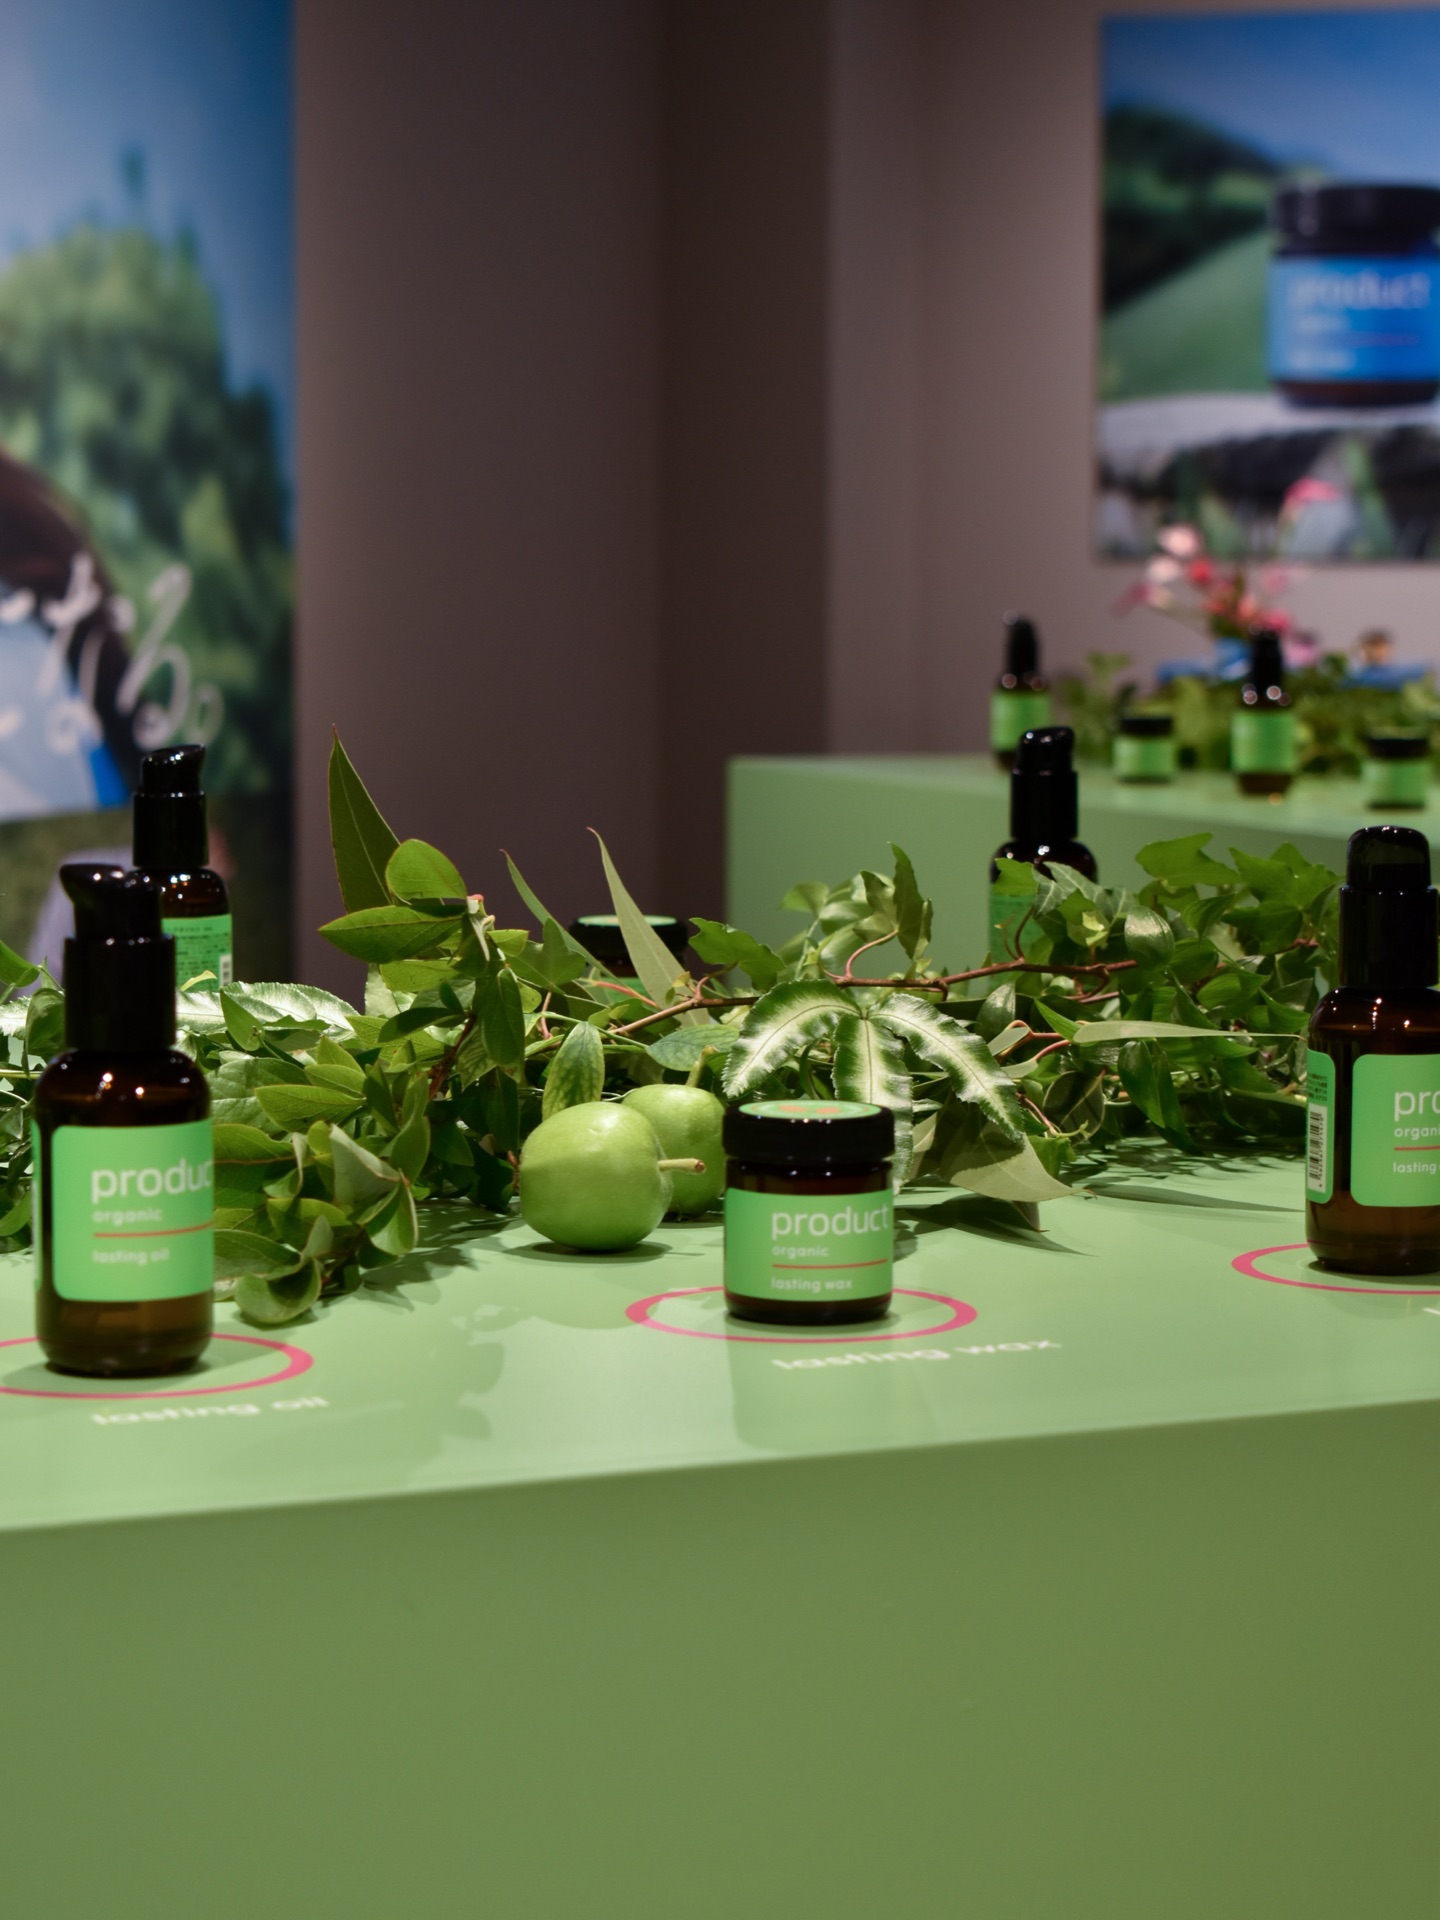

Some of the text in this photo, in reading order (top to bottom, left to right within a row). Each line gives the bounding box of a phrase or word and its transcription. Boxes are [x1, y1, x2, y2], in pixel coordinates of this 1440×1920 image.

[1392, 1161, 1437, 1175] lasting
[92, 1207, 163, 1226] organic
[771, 1204, 889, 1241] product
[92, 1248, 170, 1266] lasting oil
[772, 1245, 829, 1260] organic
[771, 1277, 852, 1294] lasting wax
[772, 1340, 1062, 1370] lasting wax
[91, 1396, 329, 1425] lasting oil
